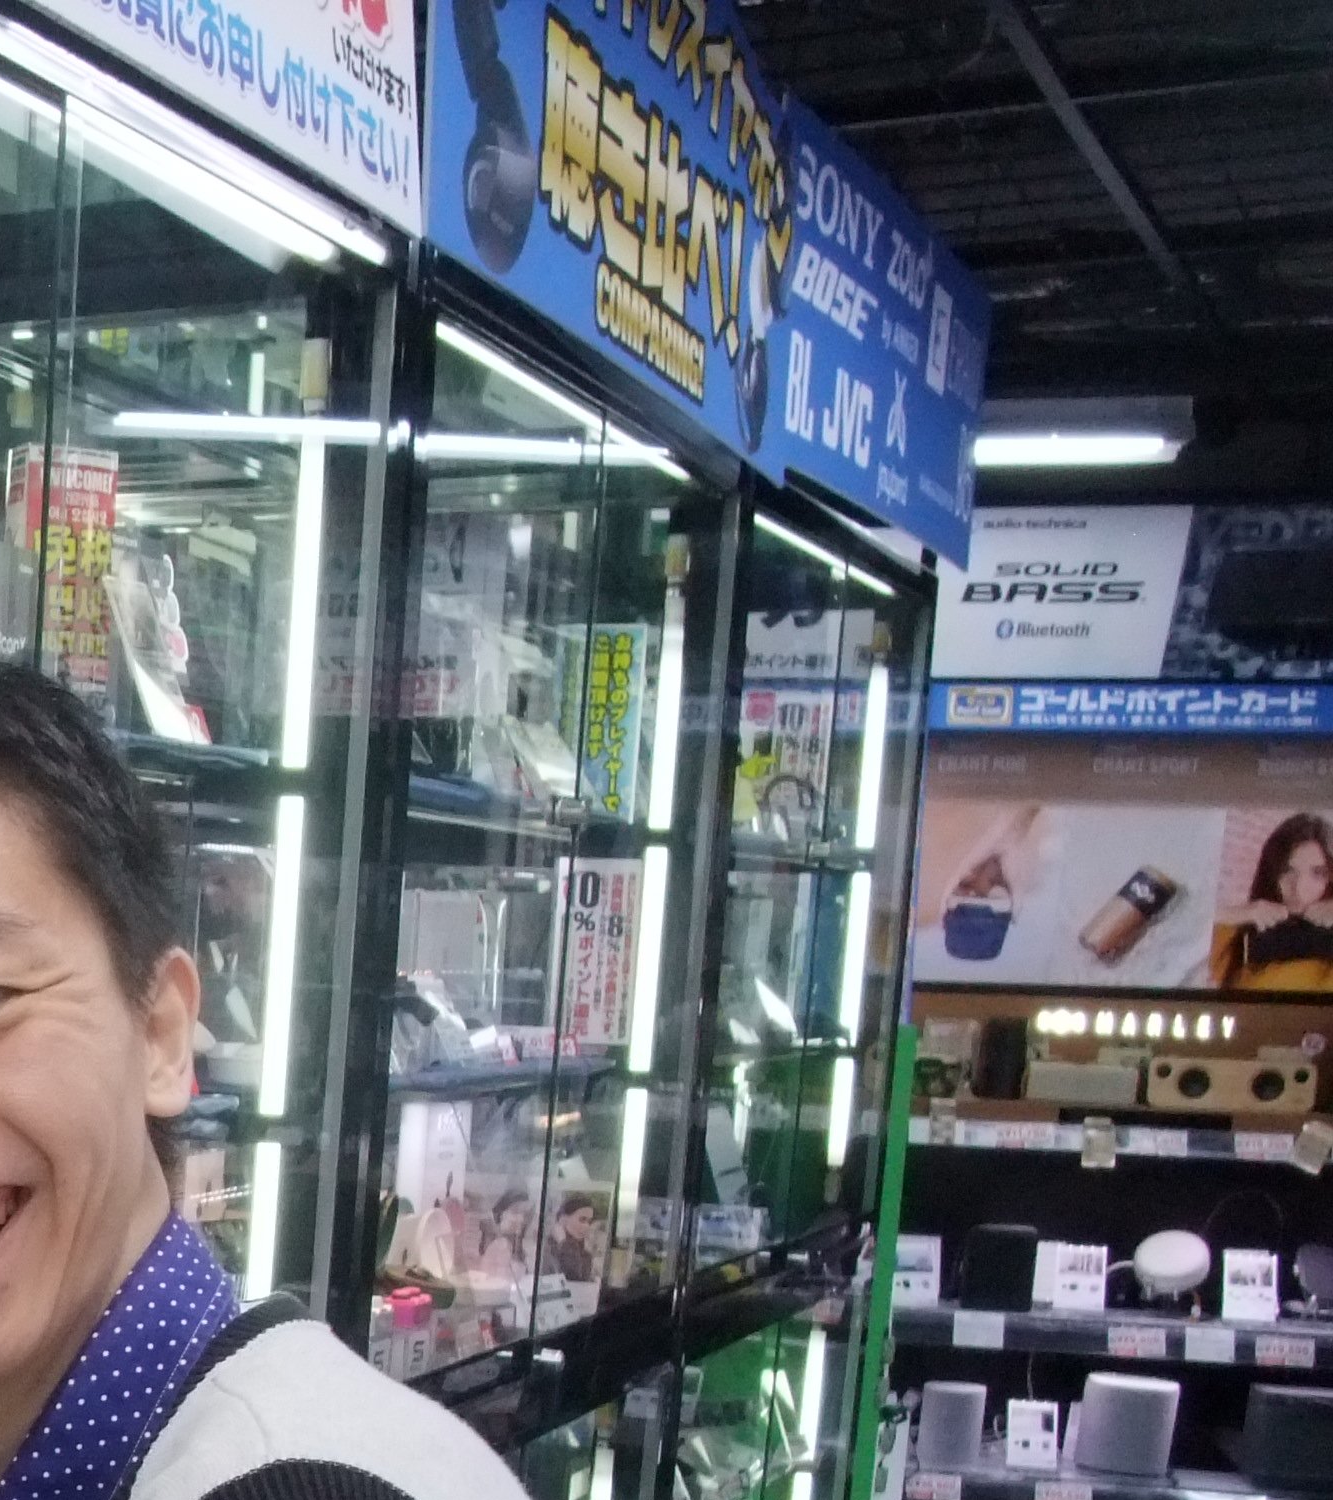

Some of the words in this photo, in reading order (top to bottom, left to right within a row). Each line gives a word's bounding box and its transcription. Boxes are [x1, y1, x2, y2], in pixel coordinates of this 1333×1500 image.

[796, 144, 884, 271] SONY
[792, 242, 879, 341] BOSE
[595, 256, 706, 405] COMPARING!
[822, 367, 874, 469] JVC
[961, 581, 1147, 604] BASS
[994, 561, 1119, 577] SOLID
[1015, 621, 1091, 639] Bluetooth
[1018, 687, 1319, 714] ゴールドポイントカード
